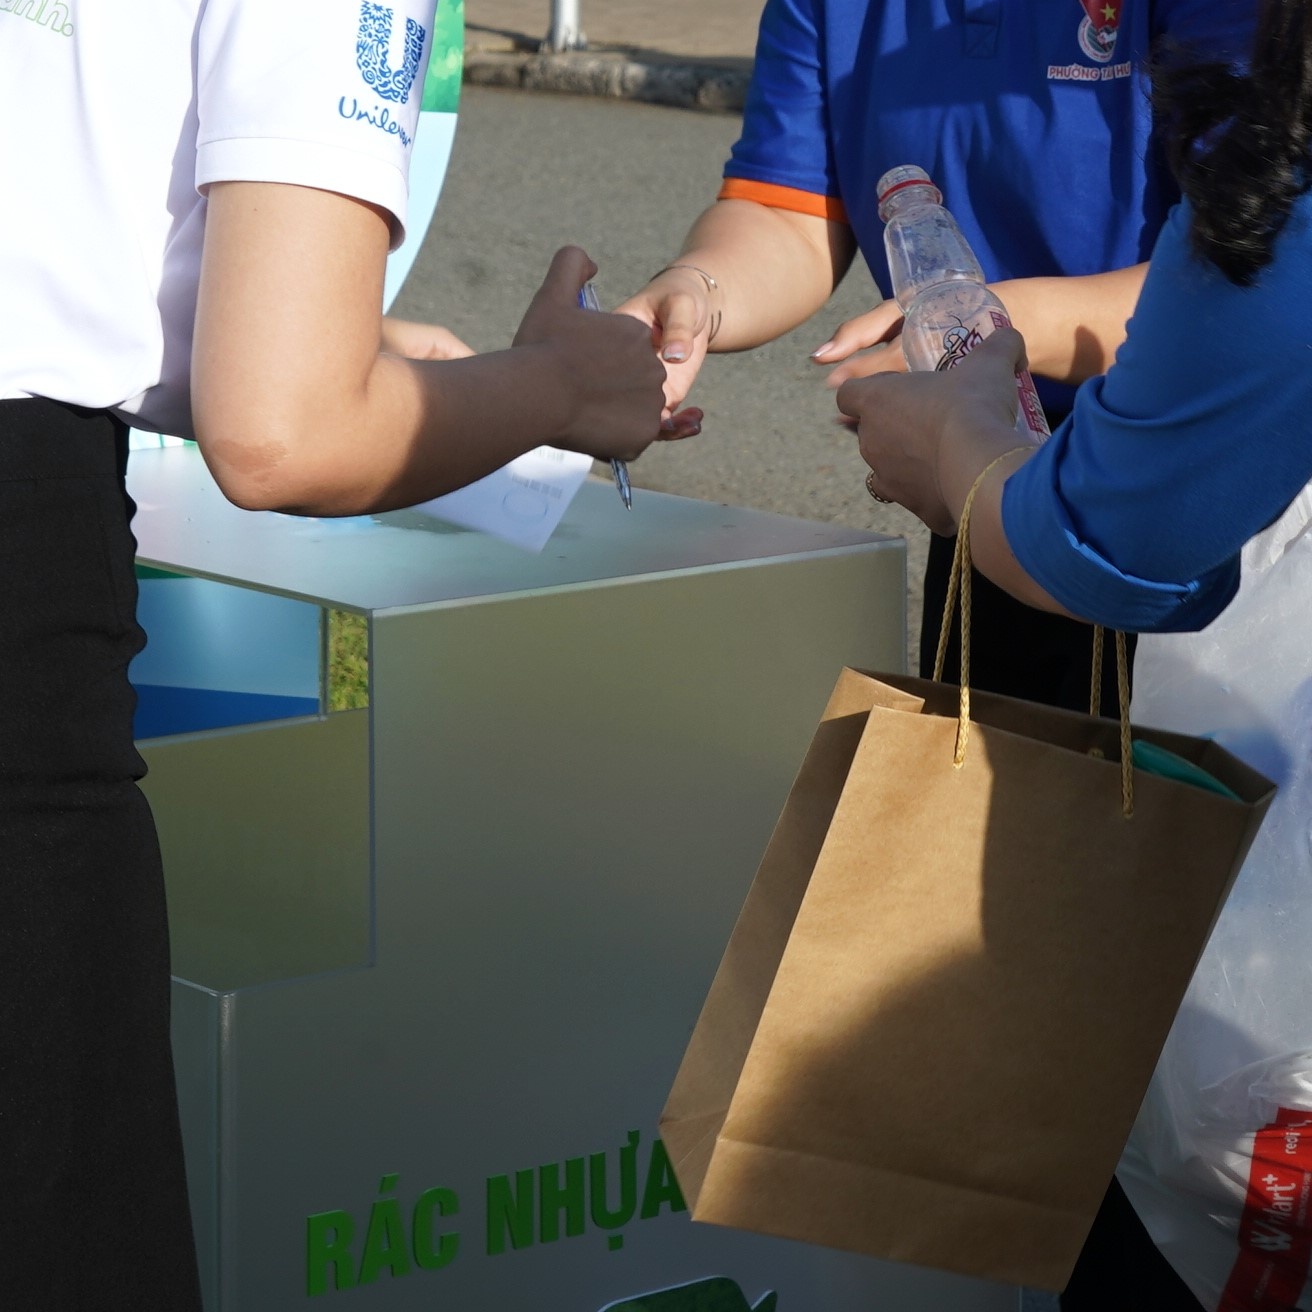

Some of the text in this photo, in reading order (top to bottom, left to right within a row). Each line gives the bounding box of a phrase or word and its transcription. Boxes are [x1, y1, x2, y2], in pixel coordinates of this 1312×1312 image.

[338, 96, 411, 148] Unilever
[306, 1129, 688, 1298] RÁC NHỰA
